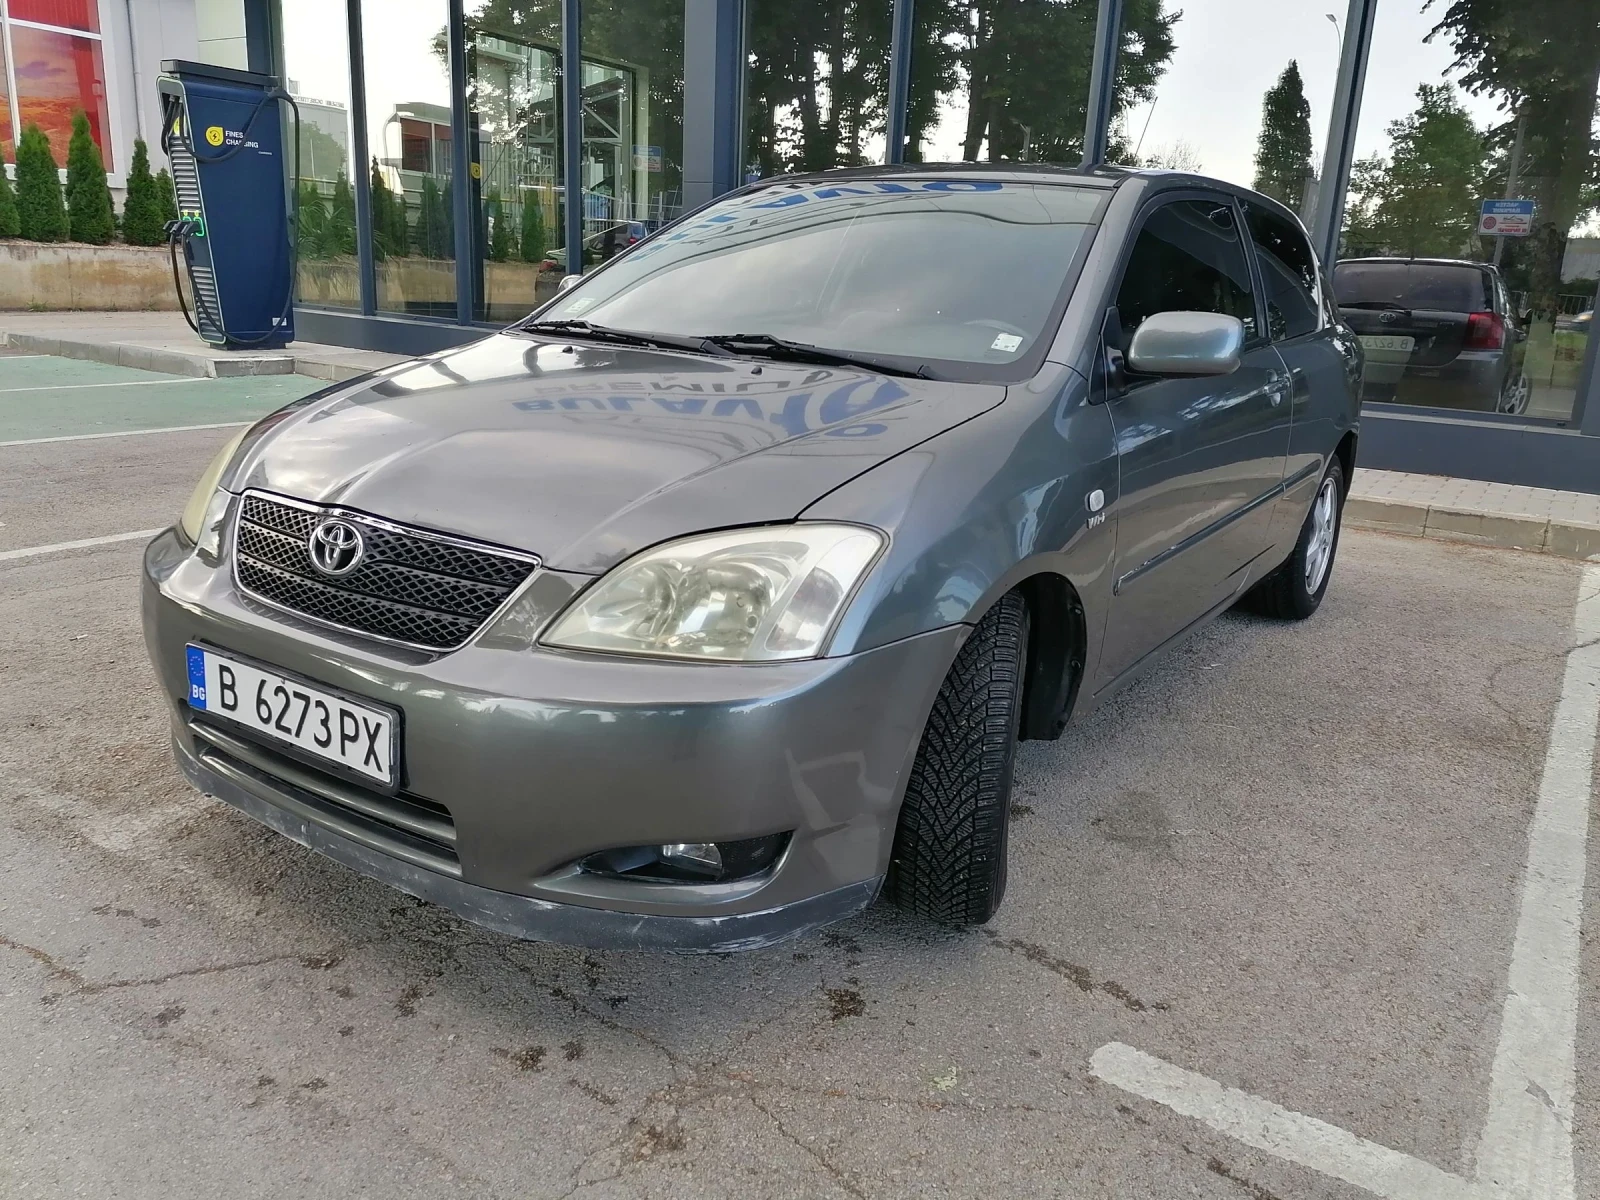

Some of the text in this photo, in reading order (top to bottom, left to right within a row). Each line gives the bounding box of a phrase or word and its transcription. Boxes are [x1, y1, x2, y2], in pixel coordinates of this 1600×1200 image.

[225, 130, 244, 139] FINES
[225, 138, 259, 148] CHAGING
[192, 684, 205, 701] BG
[218, 663, 239, 712] B
